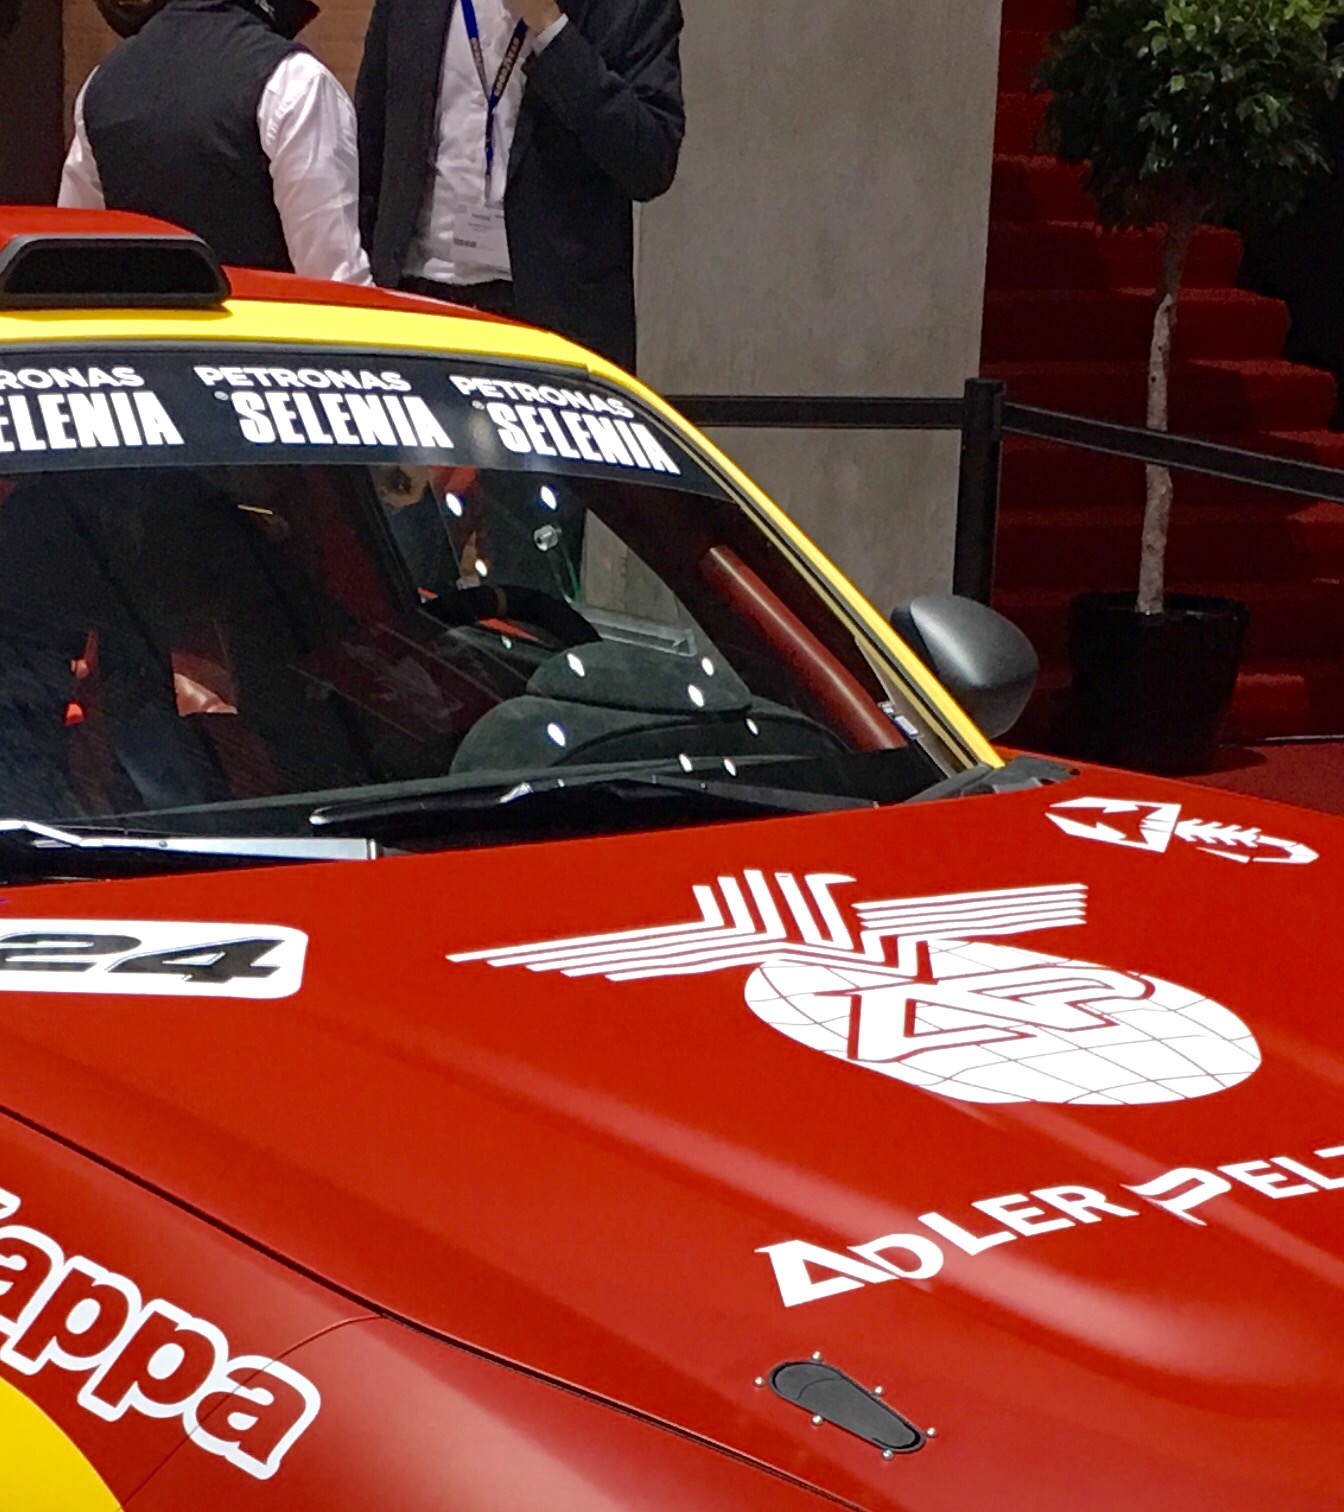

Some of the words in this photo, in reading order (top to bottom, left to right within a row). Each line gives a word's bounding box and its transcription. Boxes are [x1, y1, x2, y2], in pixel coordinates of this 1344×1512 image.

[193, 365, 413, 392] PETRONAS
[449, 375, 635, 418] PETRONAS
[231, 391, 454, 449] SELENIA
[486, 402, 681, 475] SELENIA
[753, 1185, 1140, 1308] ADLER
